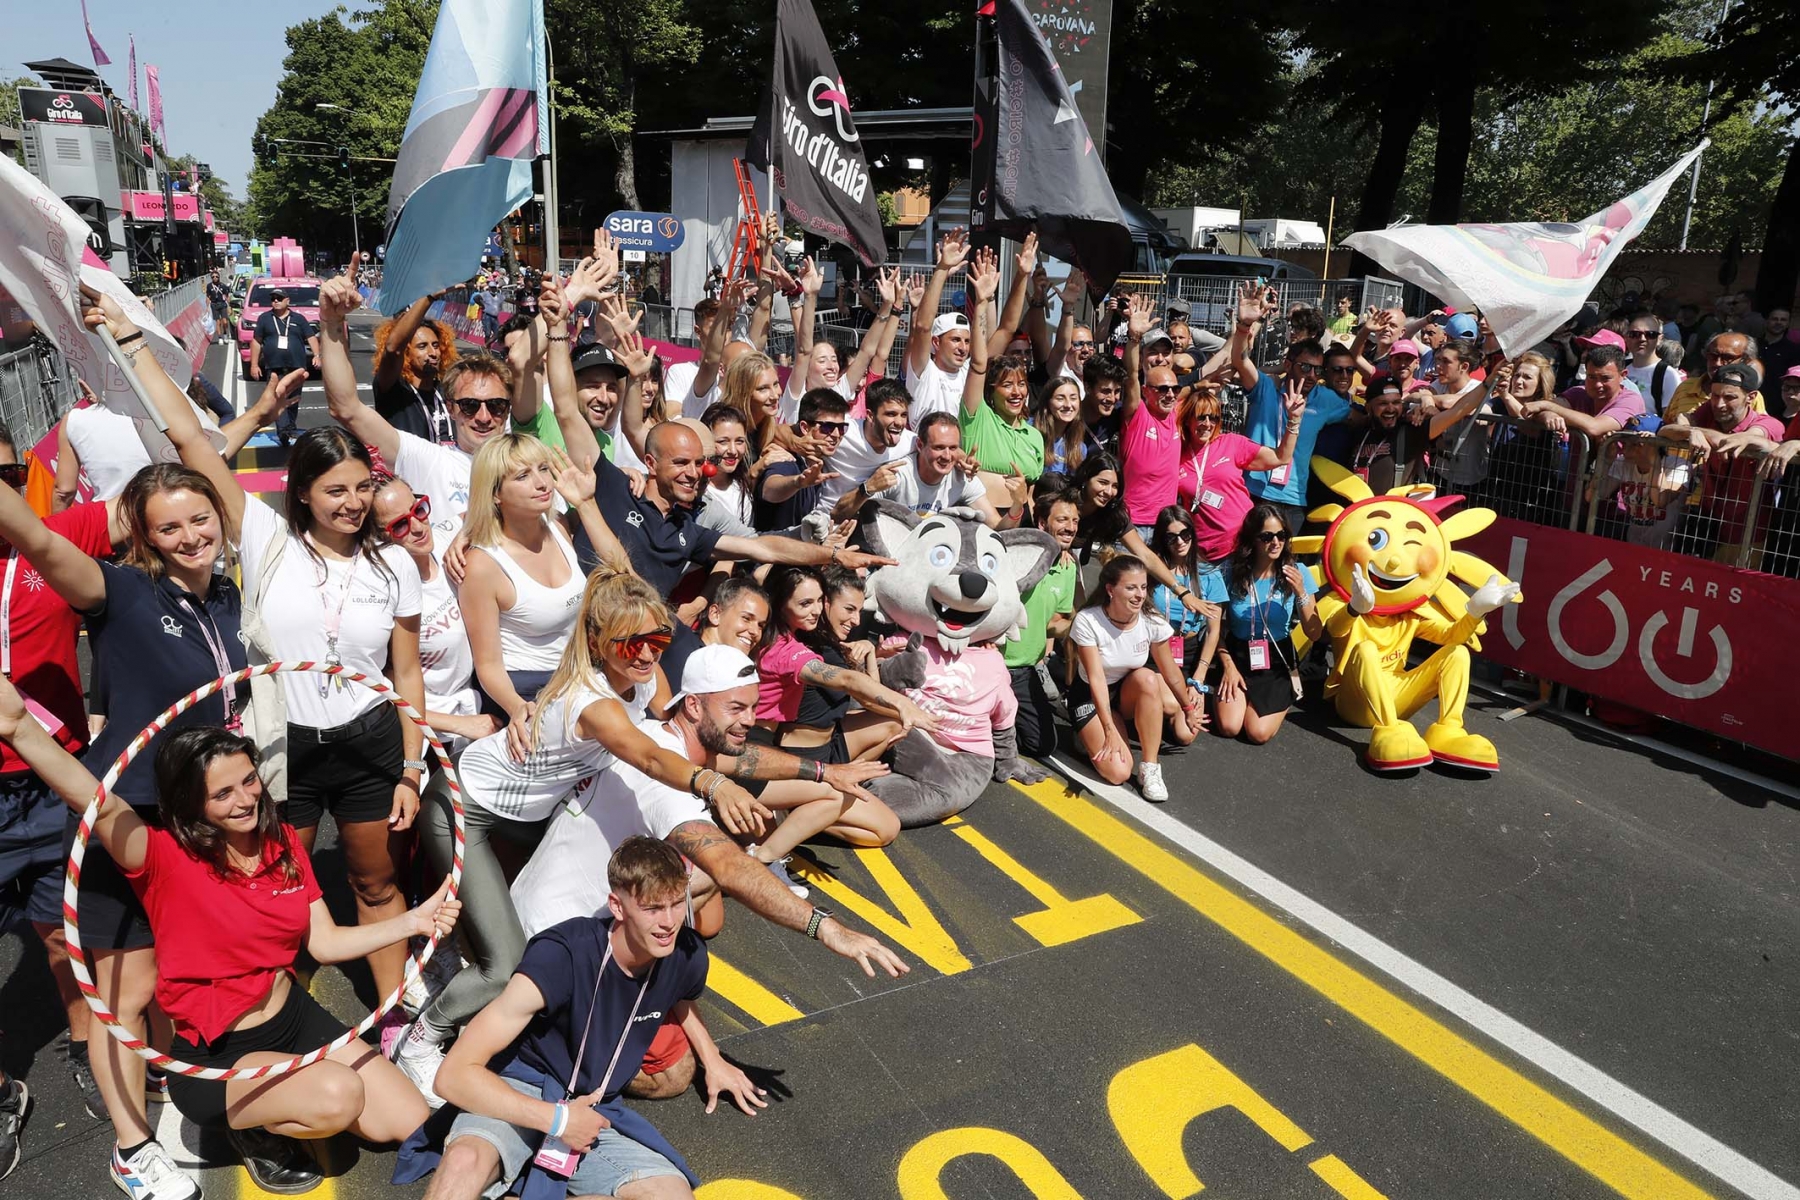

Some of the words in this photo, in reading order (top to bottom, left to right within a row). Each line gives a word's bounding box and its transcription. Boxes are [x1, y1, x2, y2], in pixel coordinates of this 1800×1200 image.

[1031, 13, 1096, 34] CAROVANA
[807, 133, 868, 204] d'Italia
[142, 202, 189, 211] LEONDO
[609, 217, 653, 234] sara
[1640, 565, 1743, 604] YEARS
[425, 606, 461, 640] AYG
